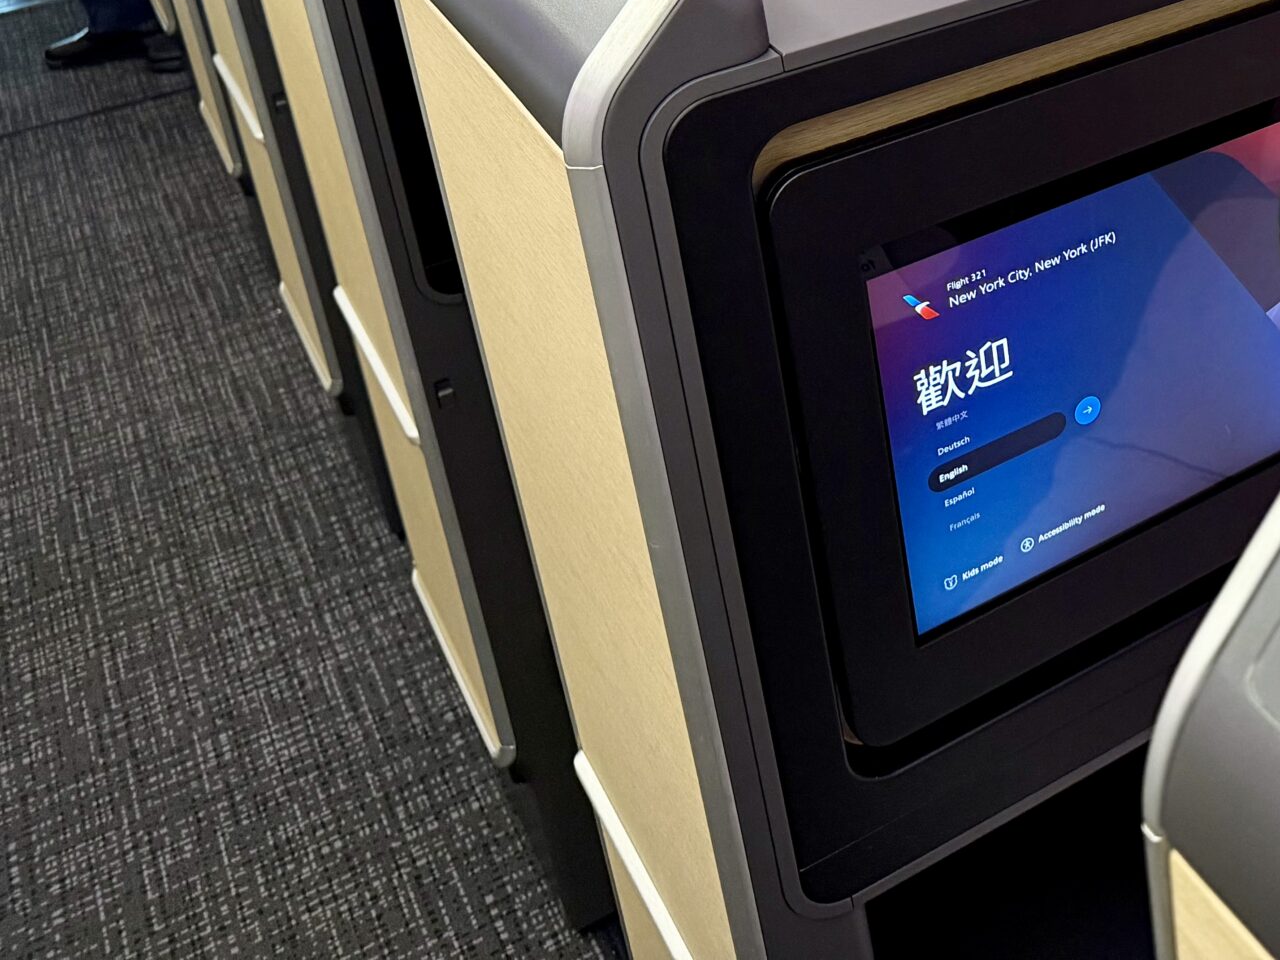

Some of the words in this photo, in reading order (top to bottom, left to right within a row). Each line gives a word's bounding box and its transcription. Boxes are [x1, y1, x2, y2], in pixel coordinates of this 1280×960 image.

[946, 276, 970, 291] Flight
[971, 269, 987, 282] 321
[948, 289, 977, 308] New
[978, 276, 1006, 295] York
[1007, 267, 1032, 284] City,
[1034, 254, 1061, 273] New
[1062, 243, 1088, 261] York
[1089, 231, 1117, 253] (JFK)
[913, 337, 1014, 416] 歡迎
[937, 435, 971, 456] Deutsch
[939, 463, 968, 483] English
[944, 487, 975, 507] Español
[950, 511, 981, 531] Français
[1038, 514, 1084, 543] Accessibility
[1084, 503, 1106, 521] mode
[962, 565, 980, 581] Kids
[980, 555, 1004, 573] mode
